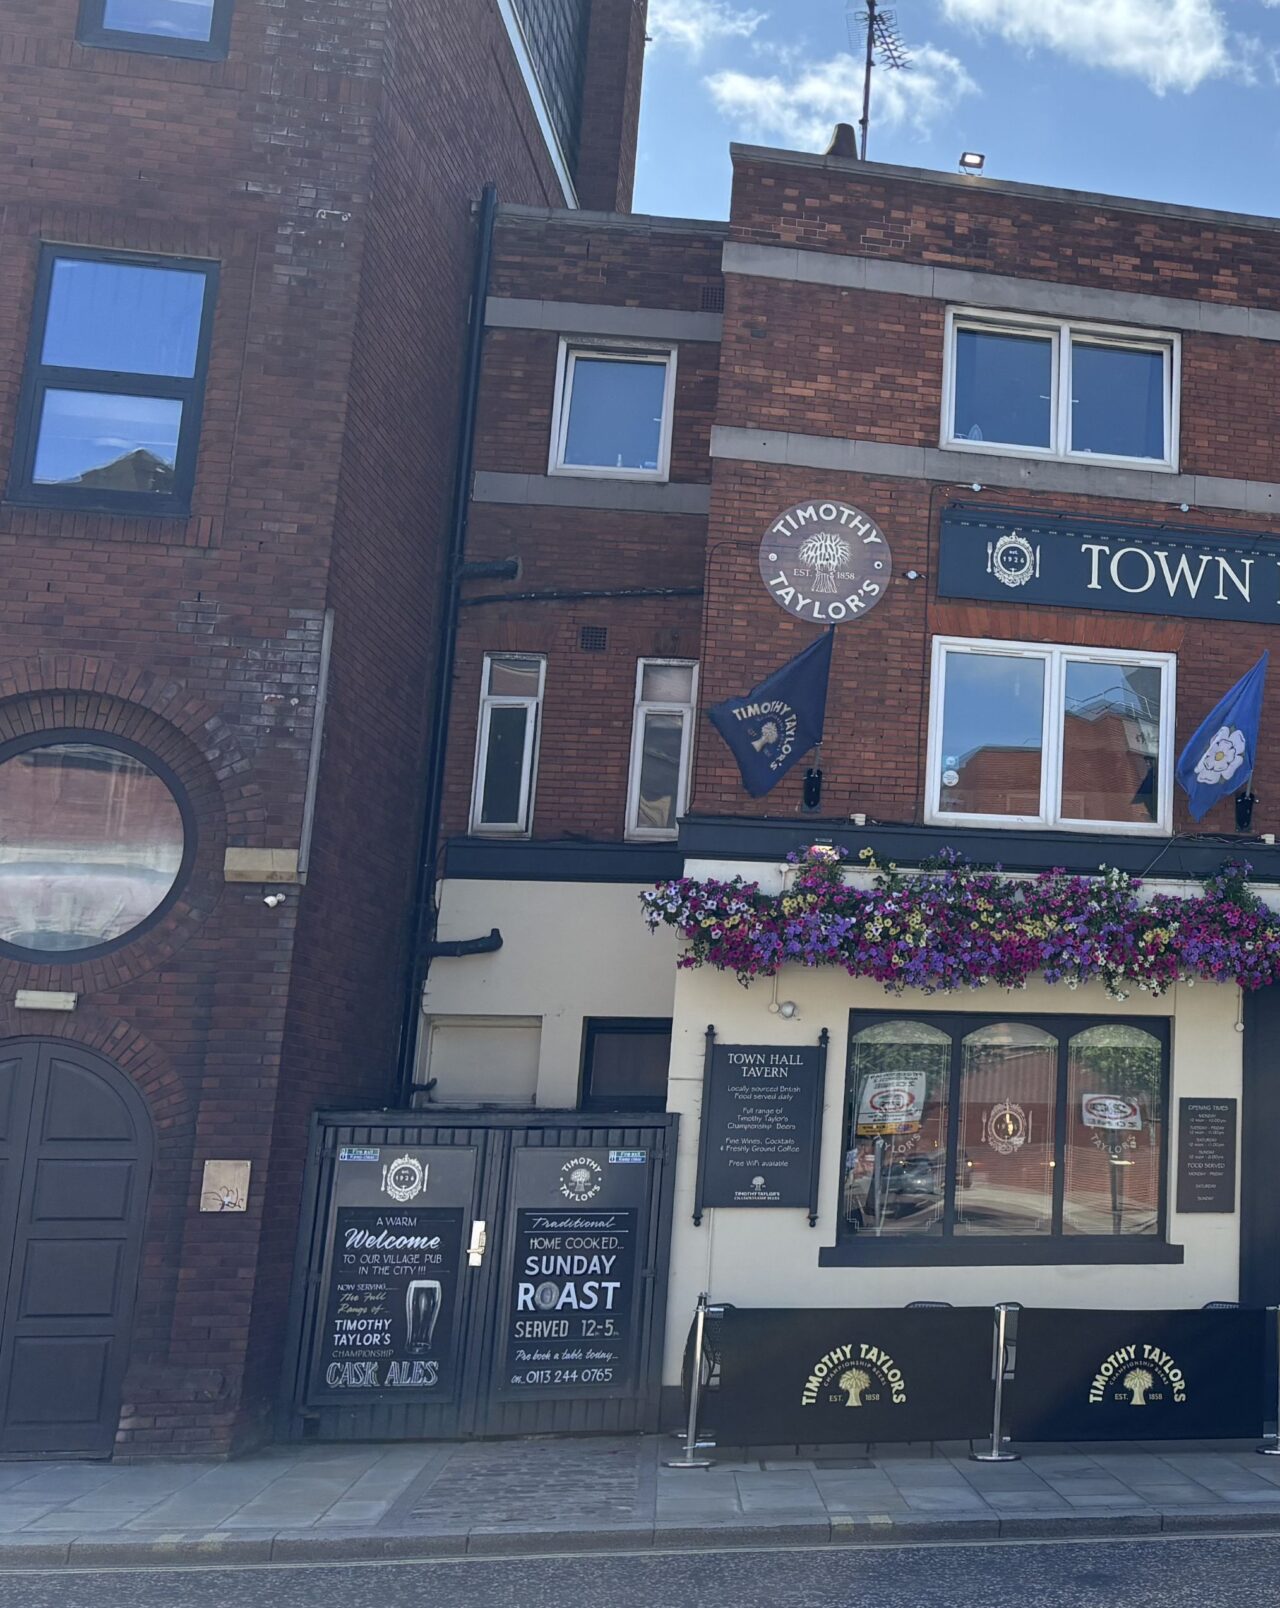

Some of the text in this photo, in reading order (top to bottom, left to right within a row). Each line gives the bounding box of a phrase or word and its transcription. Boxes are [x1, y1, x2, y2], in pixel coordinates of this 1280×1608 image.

[772, 504, 882, 545] TIMOTHY
[793, 568, 855, 580] EST. 1858
[1081, 543, 1255, 603] TOWN
[769, 571, 880, 620] TAYLOR'S
[732, 700, 791, 721] TIMOTHY
[728, 1053, 804, 1065] TOWN HALL
[741, 1066, 788, 1078] TAVERN
[737, 1114, 762, 1123] Timothy
[726, 1145, 750, 1153] Freshly
[561, 1157, 602, 1173] TIMOTHY
[560, 1184, 601, 1201] TAYLOR'S
[376, 1217, 417, 1226] A WARM
[532, 1217, 616, 1229] Traditional
[344, 1228, 441, 1250] Welcome
[530, 1238, 561, 1249] HOME
[343, 1254, 442, 1264] TO OUR VILLAGE PUB
[524, 1255, 616, 1276] SUNDAY
[359, 1266, 369, 1275] IN
[372, 1266, 390, 1275] THE
[337, 1283, 355, 1291] NOW
[340, 1292, 387, 1302] The Full
[517, 1281, 621, 1311] ROAST
[338, 1303, 367, 1316] Range
[334, 1319, 392, 1331] TIMOTHY
[514, 1320, 569, 1338] SERVED
[333, 1333, 391, 1346] TAYLOR'S
[332, 1350, 394, 1358] CHAMPIONSHIP
[532, 1349, 551, 1360] book
[561, 1349, 582, 1360] table
[326, 1361, 439, 1388] CASK ALES
[526, 1370, 551, 1384] 0113
[554, 1370, 578, 1383] 244
[581, 1368, 613, 1382] 0765
[802, 1344, 852, 1406] TIMOTHY
[823, 1360, 872, 1387] CHAMPIONSHIP
[1089, 1344, 1136, 1403] TIMOTHY
